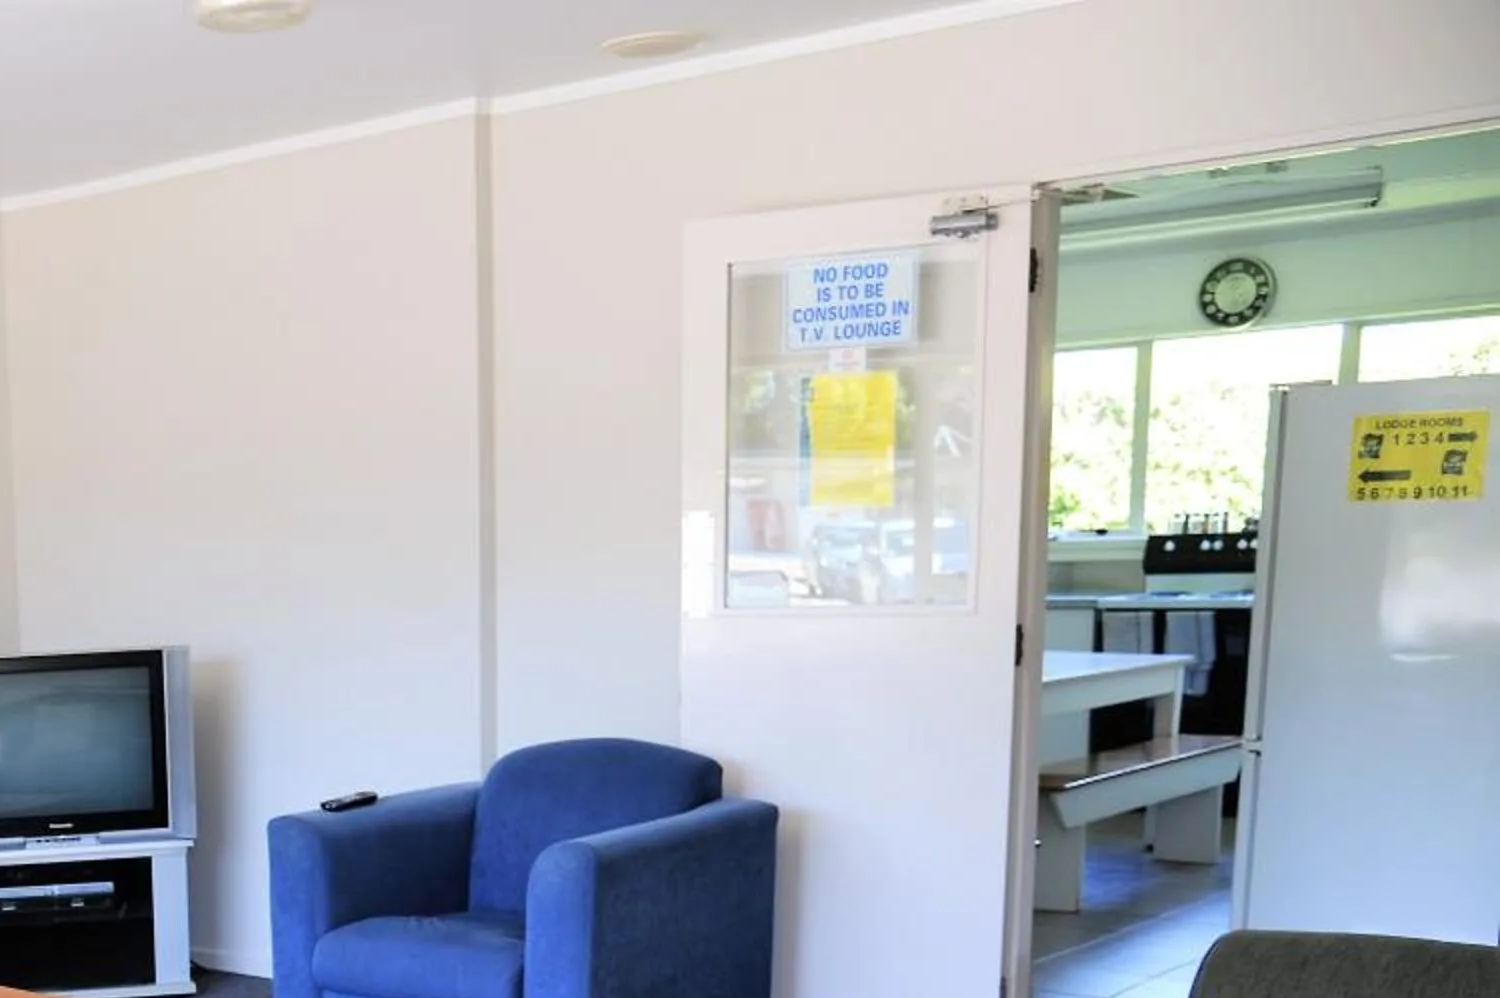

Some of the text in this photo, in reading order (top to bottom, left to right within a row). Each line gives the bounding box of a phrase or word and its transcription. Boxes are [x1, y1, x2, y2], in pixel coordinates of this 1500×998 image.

[813, 262, 888, 283] NO FOOD
[817, 282, 884, 302] IS TO BE
[792, 299, 909, 323] CONSUMED IN
[834, 321, 901, 340] LOUNGE
[1375, 417, 1463, 429] LODGE ROOMS
[1392, 431, 1445, 446] 1 2 3 4
[1357, 487, 1366, 500] 5
[1413, 486, 1422, 499] 9
[1428, 486, 1446, 498] 10
[1451, 485, 1468, 498] 11
